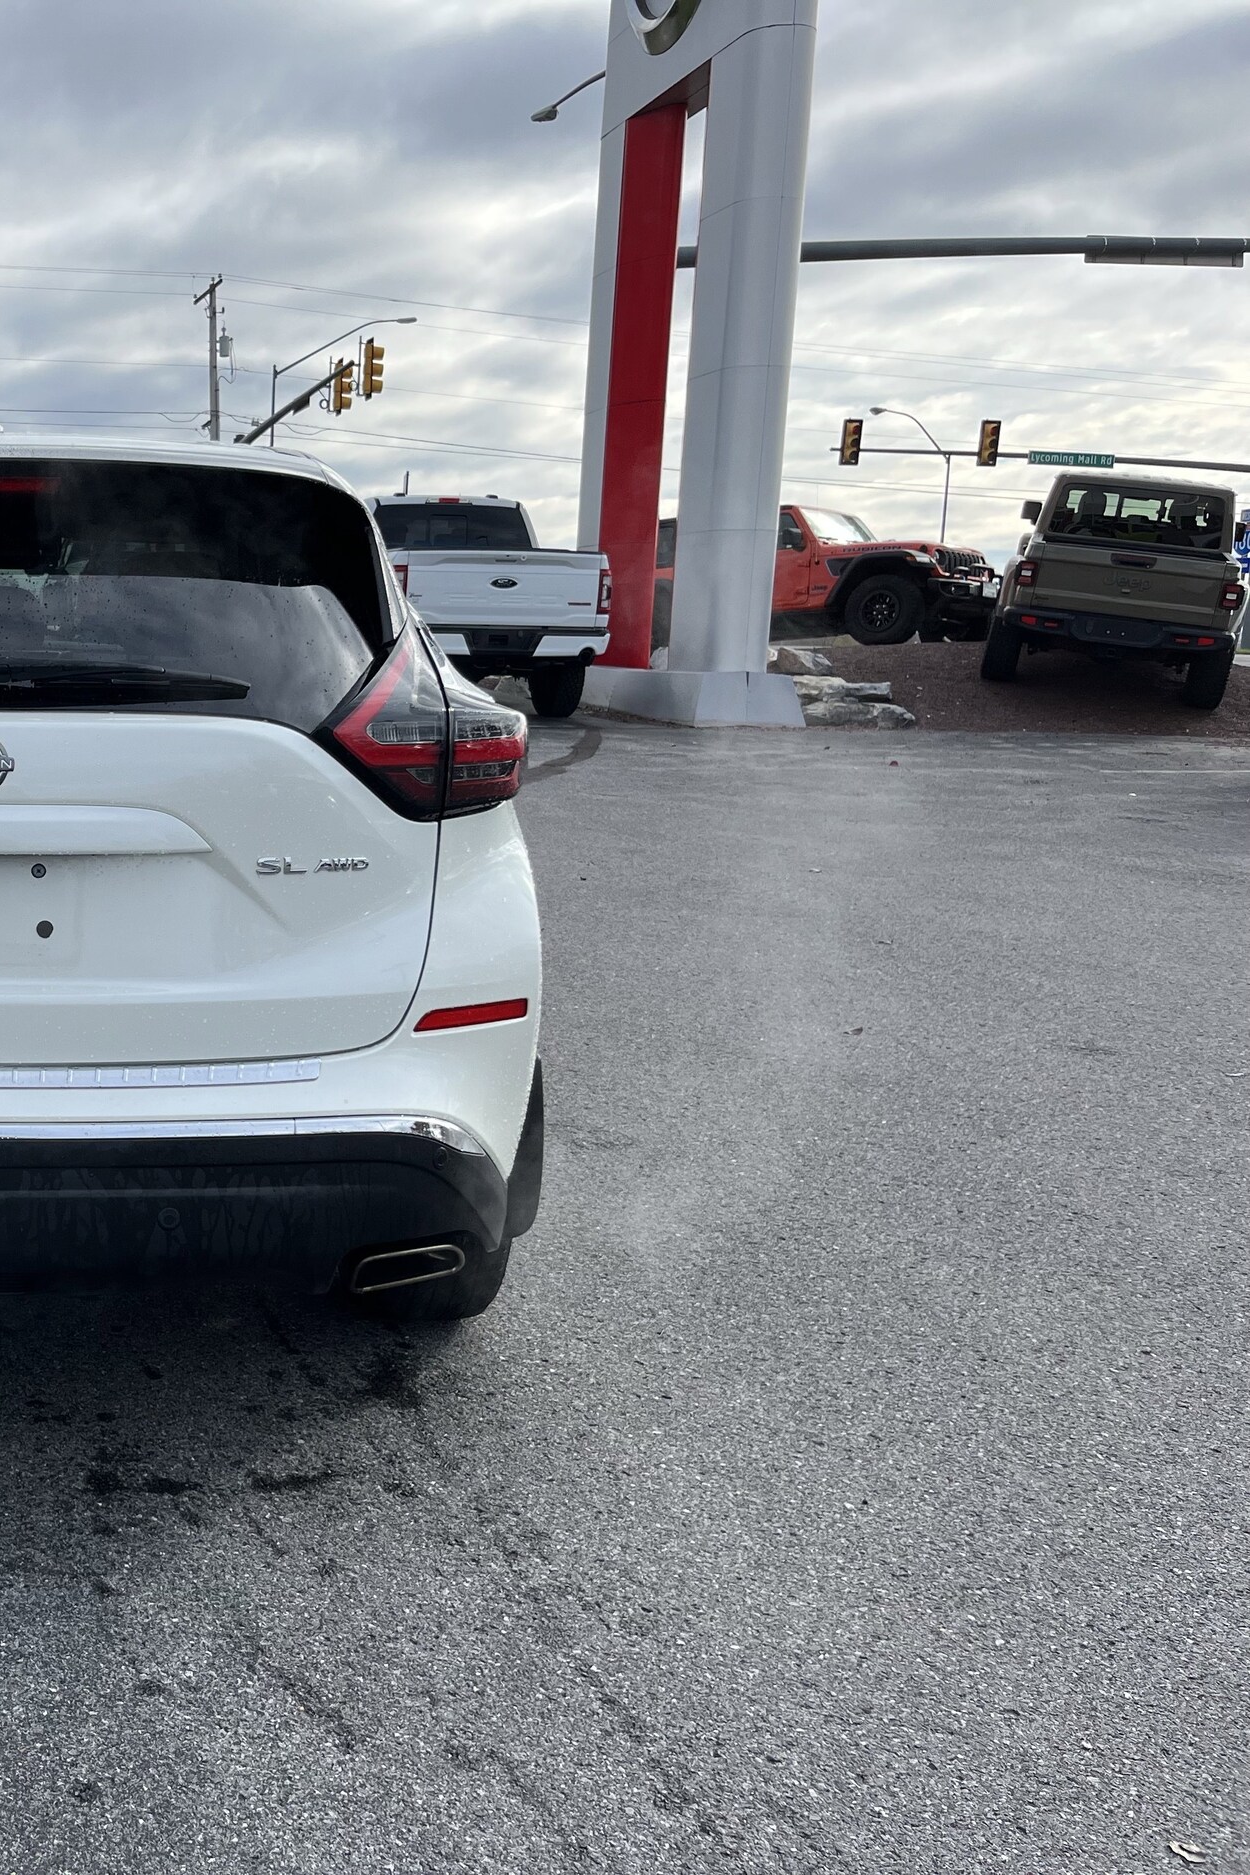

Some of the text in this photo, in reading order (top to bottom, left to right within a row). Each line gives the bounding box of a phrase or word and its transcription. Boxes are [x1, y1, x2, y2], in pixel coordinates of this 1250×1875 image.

[1031, 452, 1113, 466] Lycoming Mall Rd
[842, 545, 902, 553] RUBICON
[1103, 570, 1152, 592] Jeep
[255, 856, 370, 875] SL AWD
